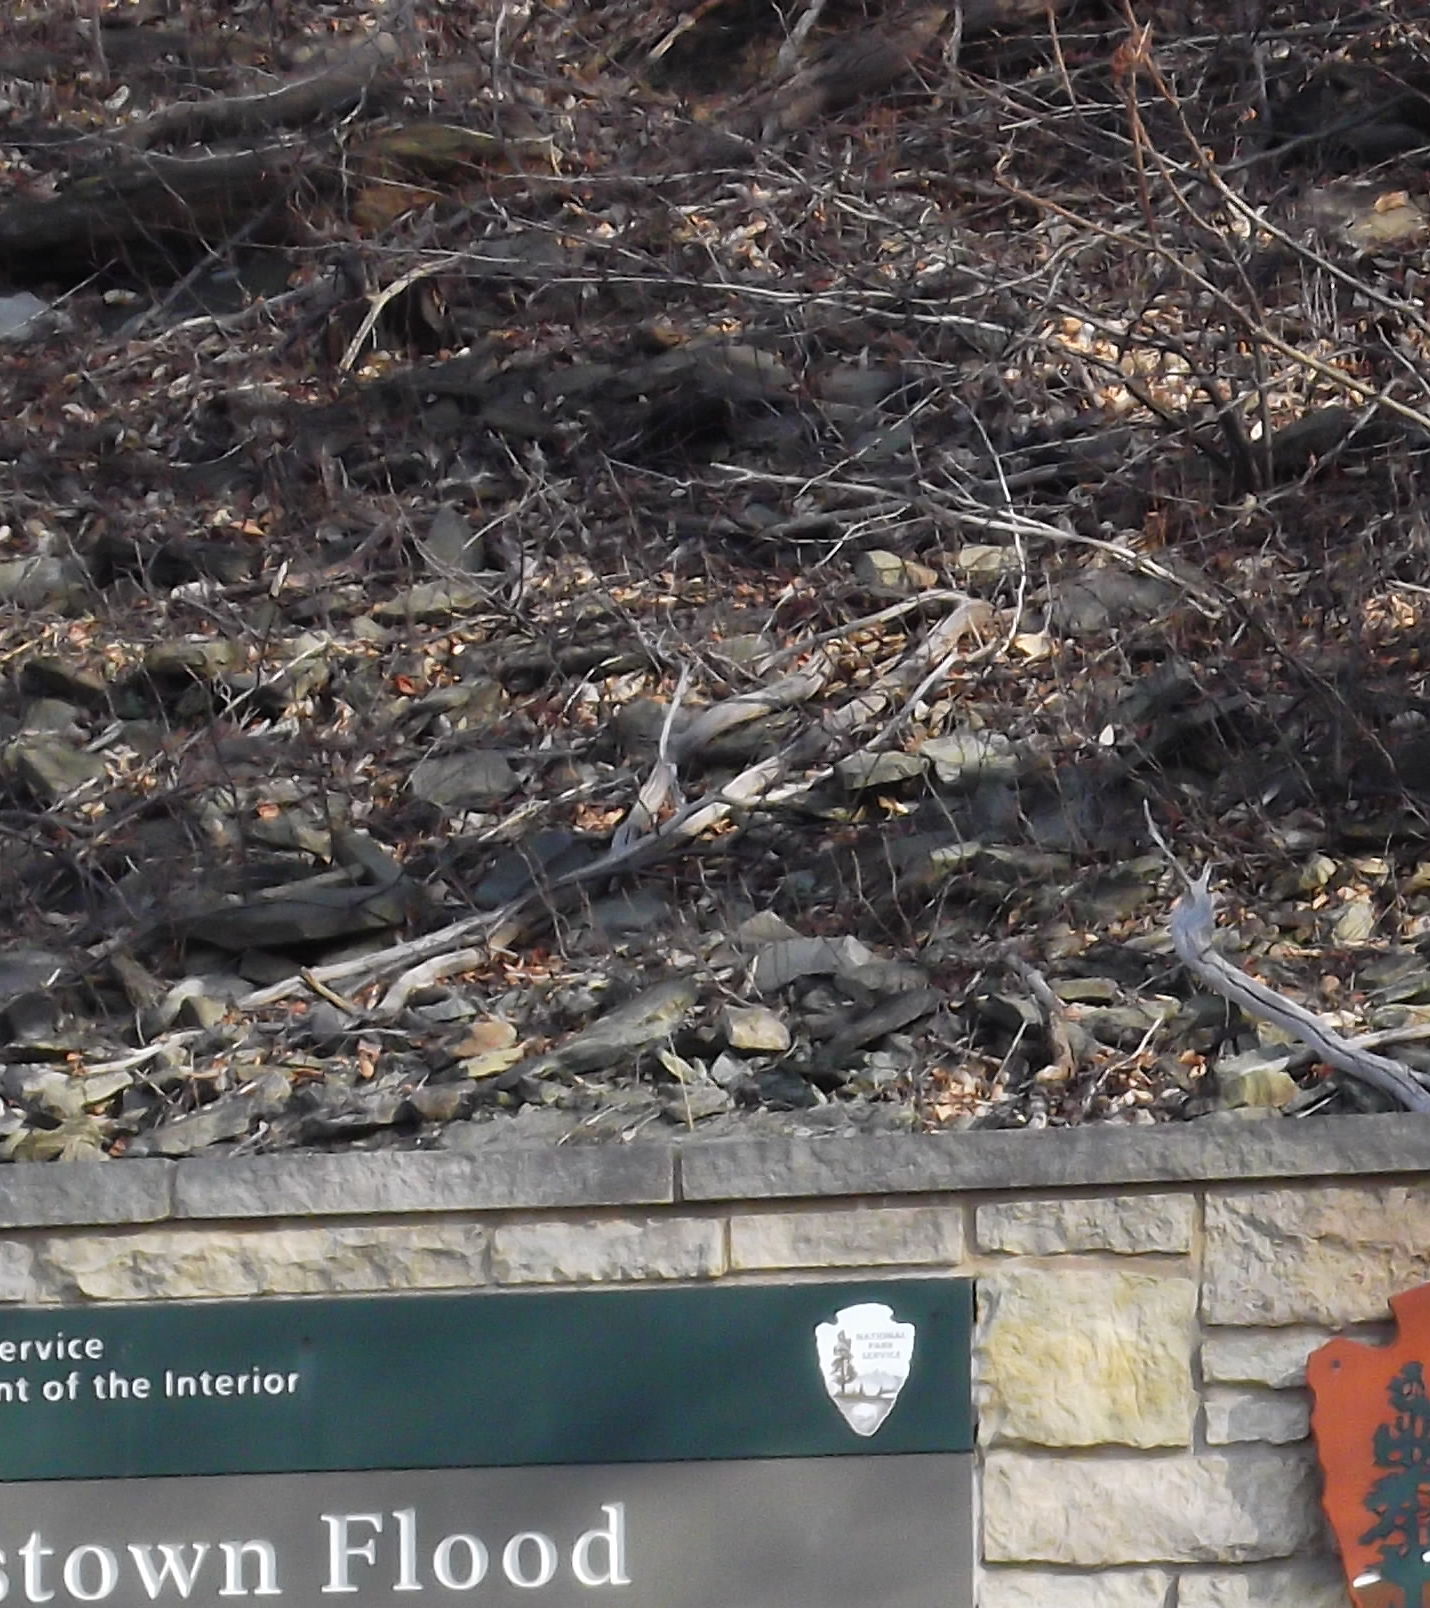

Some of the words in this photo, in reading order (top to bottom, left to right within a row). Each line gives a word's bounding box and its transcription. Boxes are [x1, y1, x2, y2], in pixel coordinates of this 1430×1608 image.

[42, 1371, 80, 1402] of
[94, 1371, 151, 1401] the
[165, 1366, 301, 1398] Interior
[320, 1502, 632, 1595] Flood
